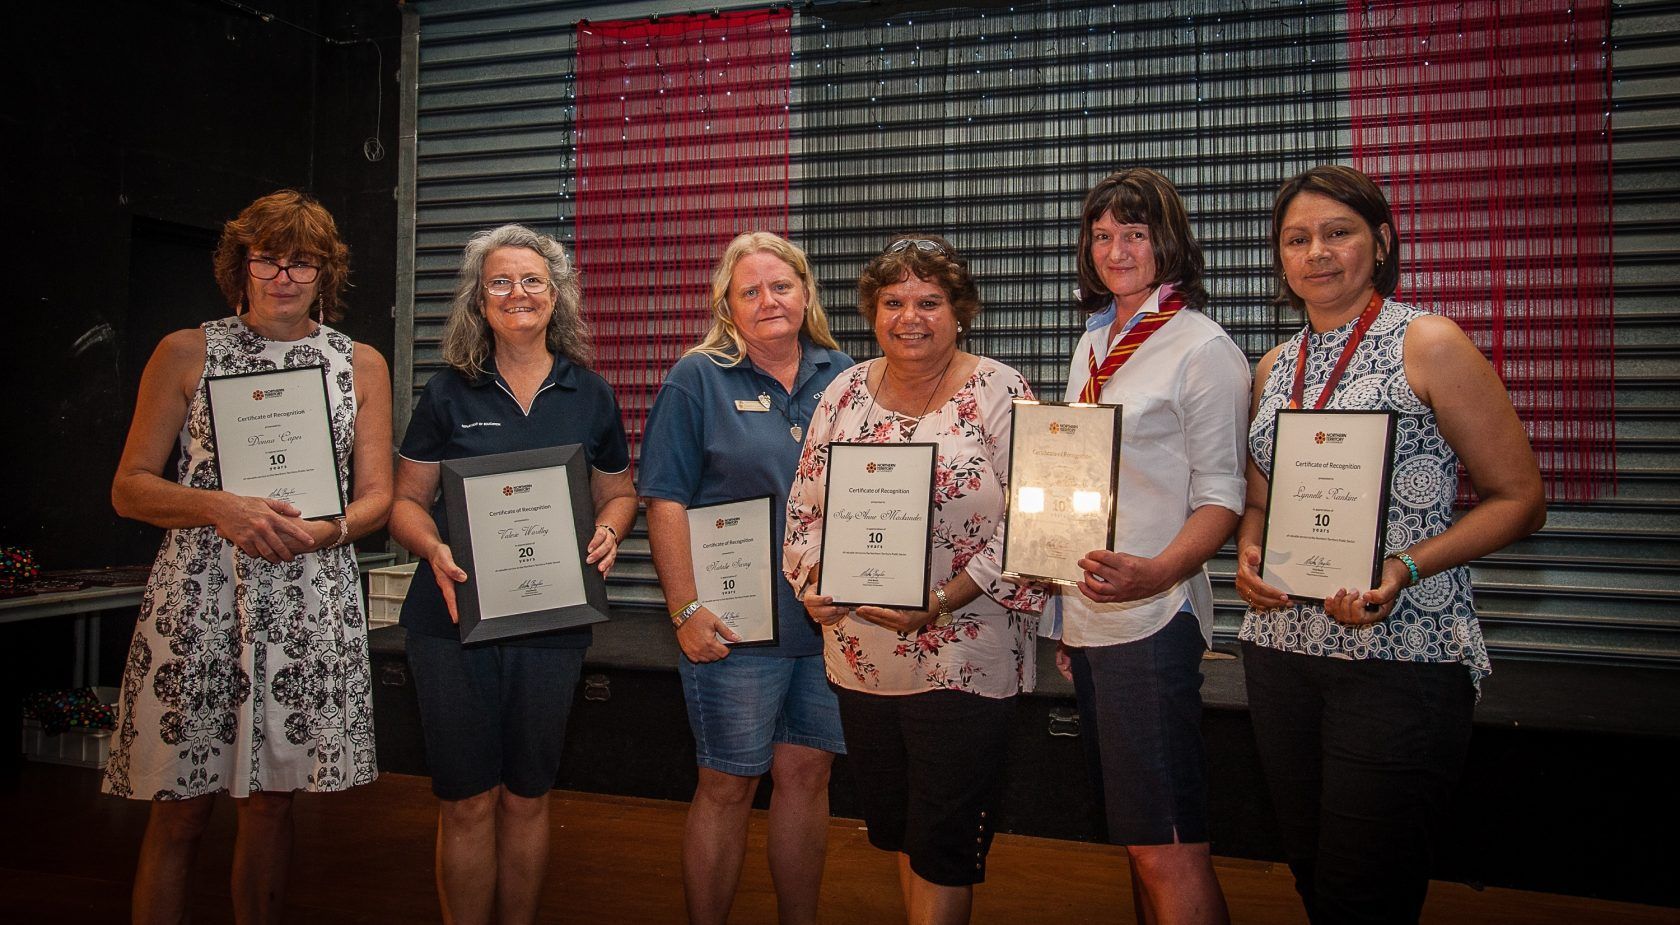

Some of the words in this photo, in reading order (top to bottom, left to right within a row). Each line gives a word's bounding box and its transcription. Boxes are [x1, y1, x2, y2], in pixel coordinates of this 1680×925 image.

[238, 414, 266, 422] Certificate
[273, 410, 305, 418] Recognition
[269, 454, 285, 465] 10
[522, 504, 551, 512] Recognition
[1053, 500, 1065, 512] 10
[1315, 513, 1330, 526] 10
[869, 532, 882, 543] 10
[519, 547, 533, 558] 20
[723, 579, 735, 590] 10
